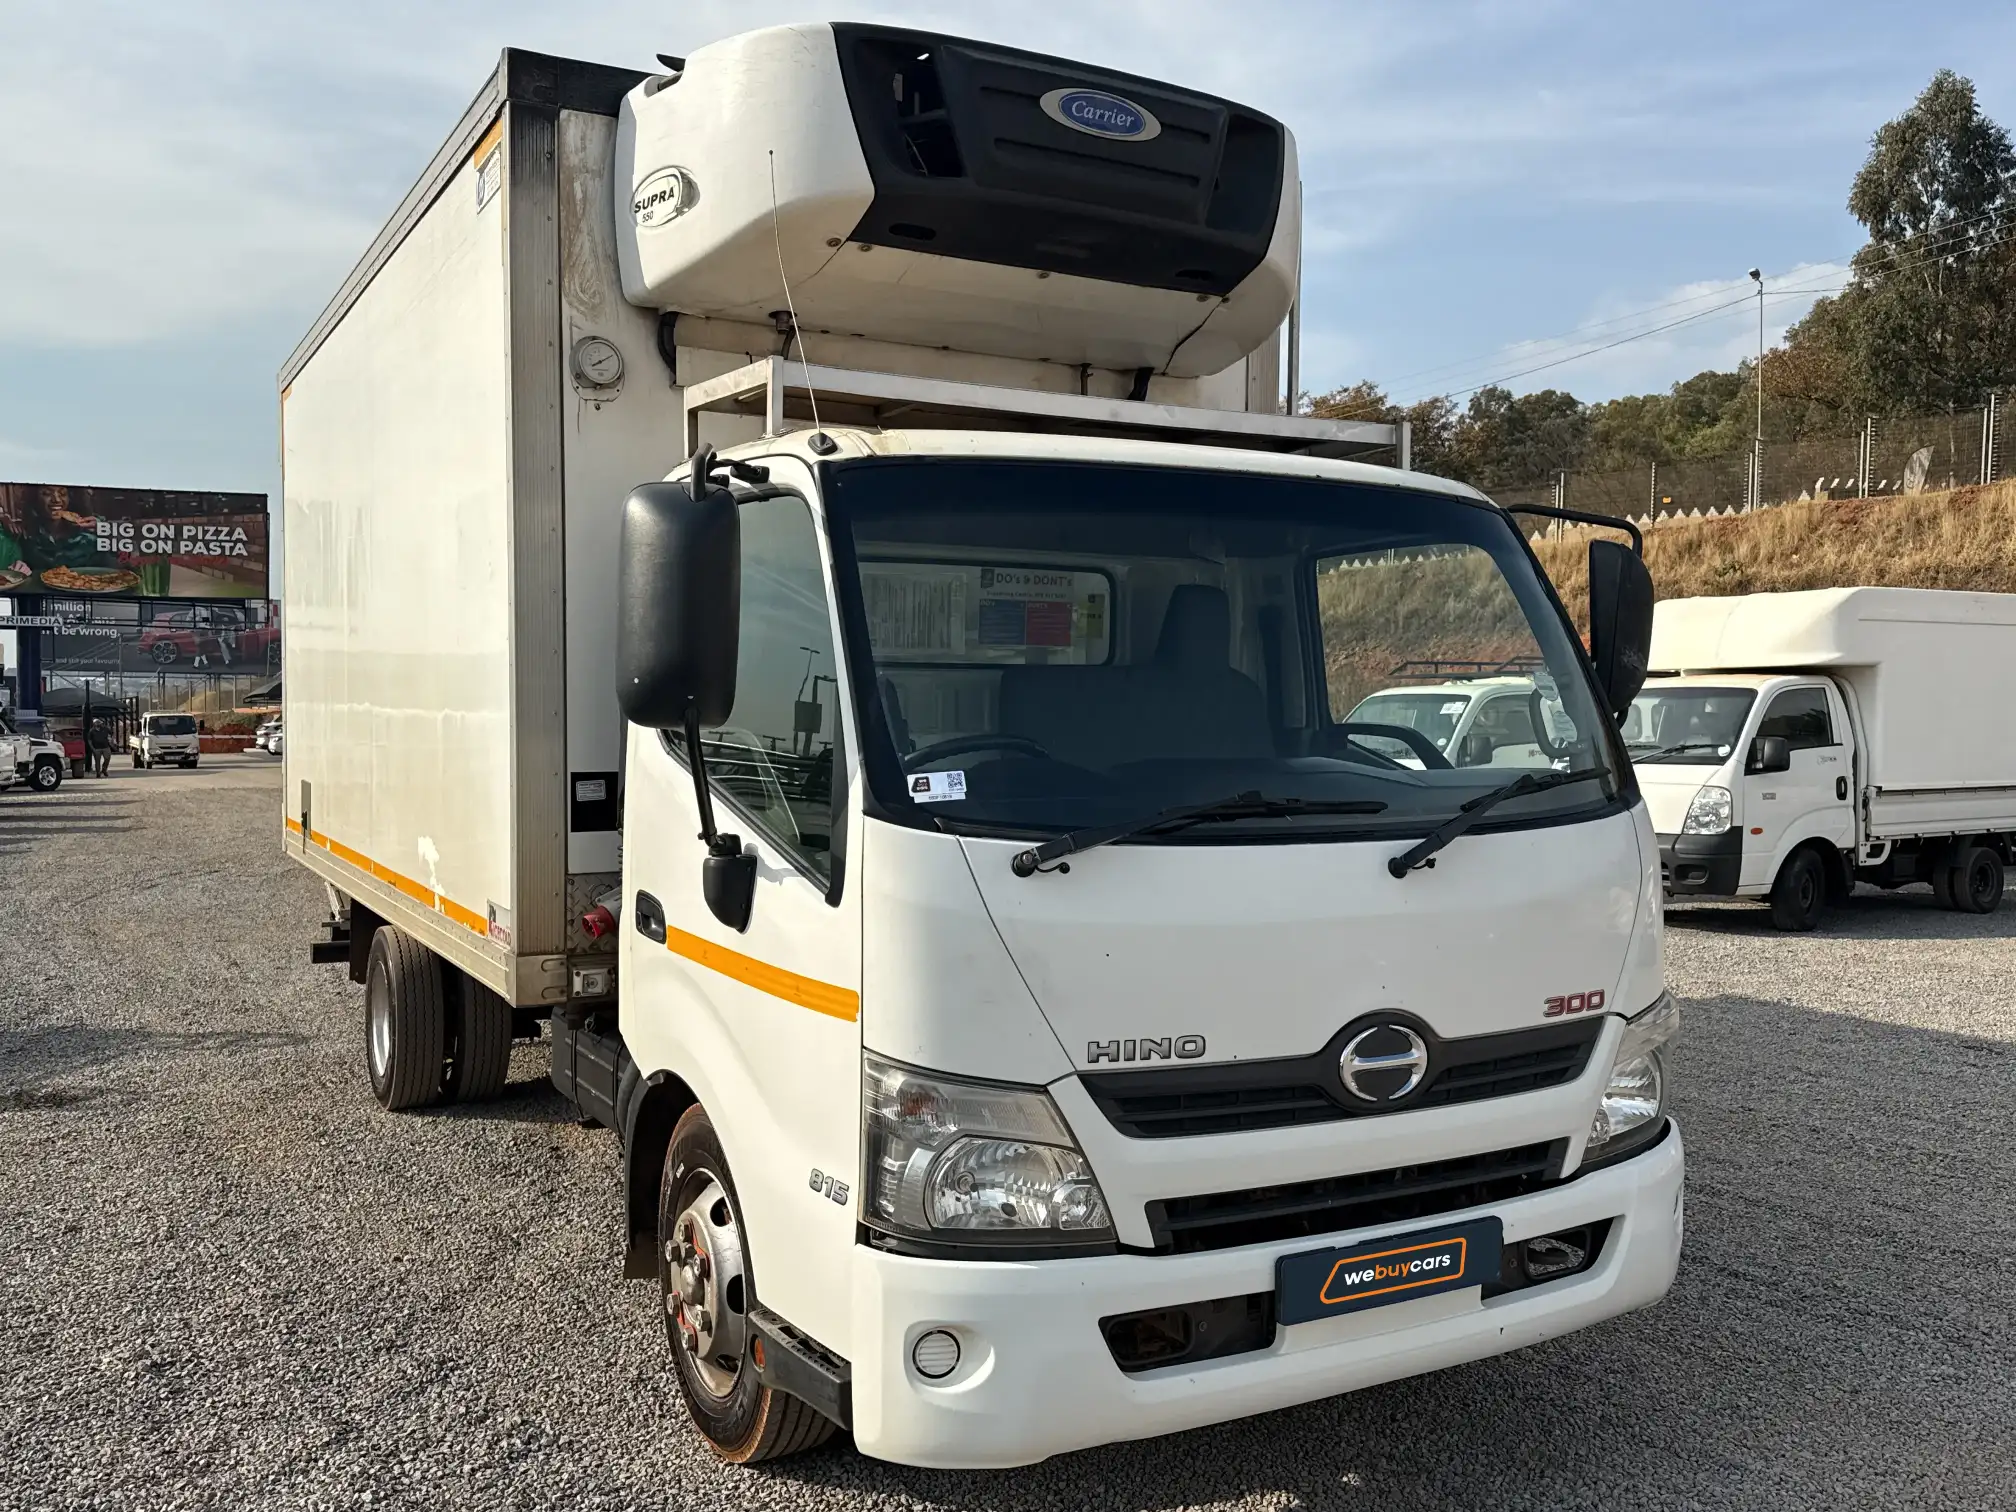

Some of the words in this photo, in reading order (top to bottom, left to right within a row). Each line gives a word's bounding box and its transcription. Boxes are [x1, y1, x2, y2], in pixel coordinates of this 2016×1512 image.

[1071, 100, 1135, 128] Carrier
[634, 186, 675, 214] SUPRA
[642, 210, 654, 223] 550
[96, 521, 135, 537] BIG
[141, 523, 175, 539] ON
[182, 525, 248, 541] PIZZA
[96, 537, 134, 552] BIG
[140, 539, 173, 554] ON
[180, 540, 248, 556] PASTA
[61, 625, 76, 636] be
[1543, 989, 1605, 1018] 300
[1087, 1034, 1206, 1064] HINO
[808, 1168, 850, 1206] 815
[1344, 1254, 1451, 1286] webuycars
